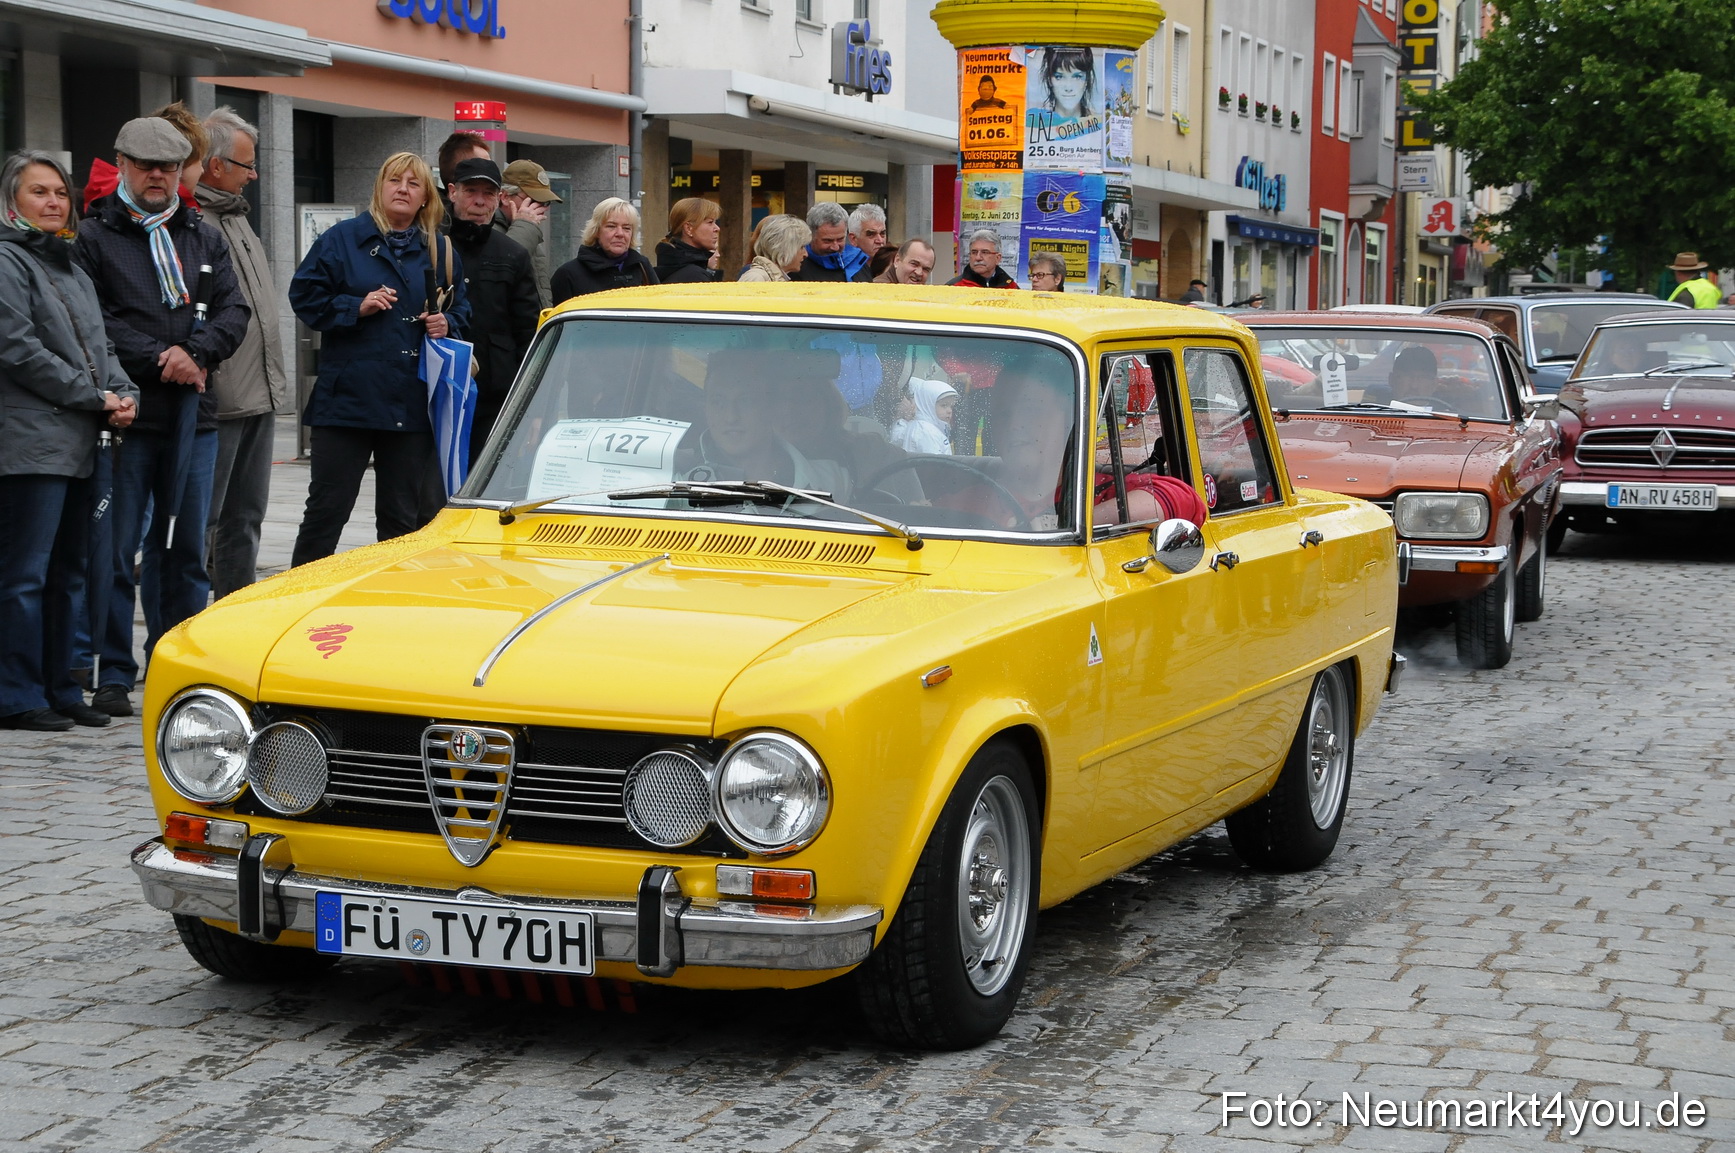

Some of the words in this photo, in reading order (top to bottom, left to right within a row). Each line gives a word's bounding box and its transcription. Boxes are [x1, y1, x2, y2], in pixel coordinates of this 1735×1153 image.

[845, 19, 892, 95] fries
[965, 64, 1022, 74] Flohmarkt
[968, 115, 1013, 126] Samstag
[969, 128, 1010, 140] 01.06.
[1028, 112, 1055, 144] ZAZ
[1058, 122, 1084, 140] OPEN
[1087, 118, 1101, 132] AIR
[963, 151, 1017, 161] Volksfestplatz
[1028, 146, 1059, 157] 25.6.
[1403, 166, 1428, 174] Stern
[818, 175, 864, 188] FRIES
[962, 212, 980, 220] Sonntag,
[1002, 212, 1020, 220] 2013
[1032, 243, 1058, 251] Metal
[1062, 243, 1086, 253] Night
[604, 433, 649, 455] 127
[1619, 489, 1638, 505] AN
[1649, 489, 1668, 505] RV
[344, 903, 400, 951] FÜ
[325, 929, 334, 942] D
